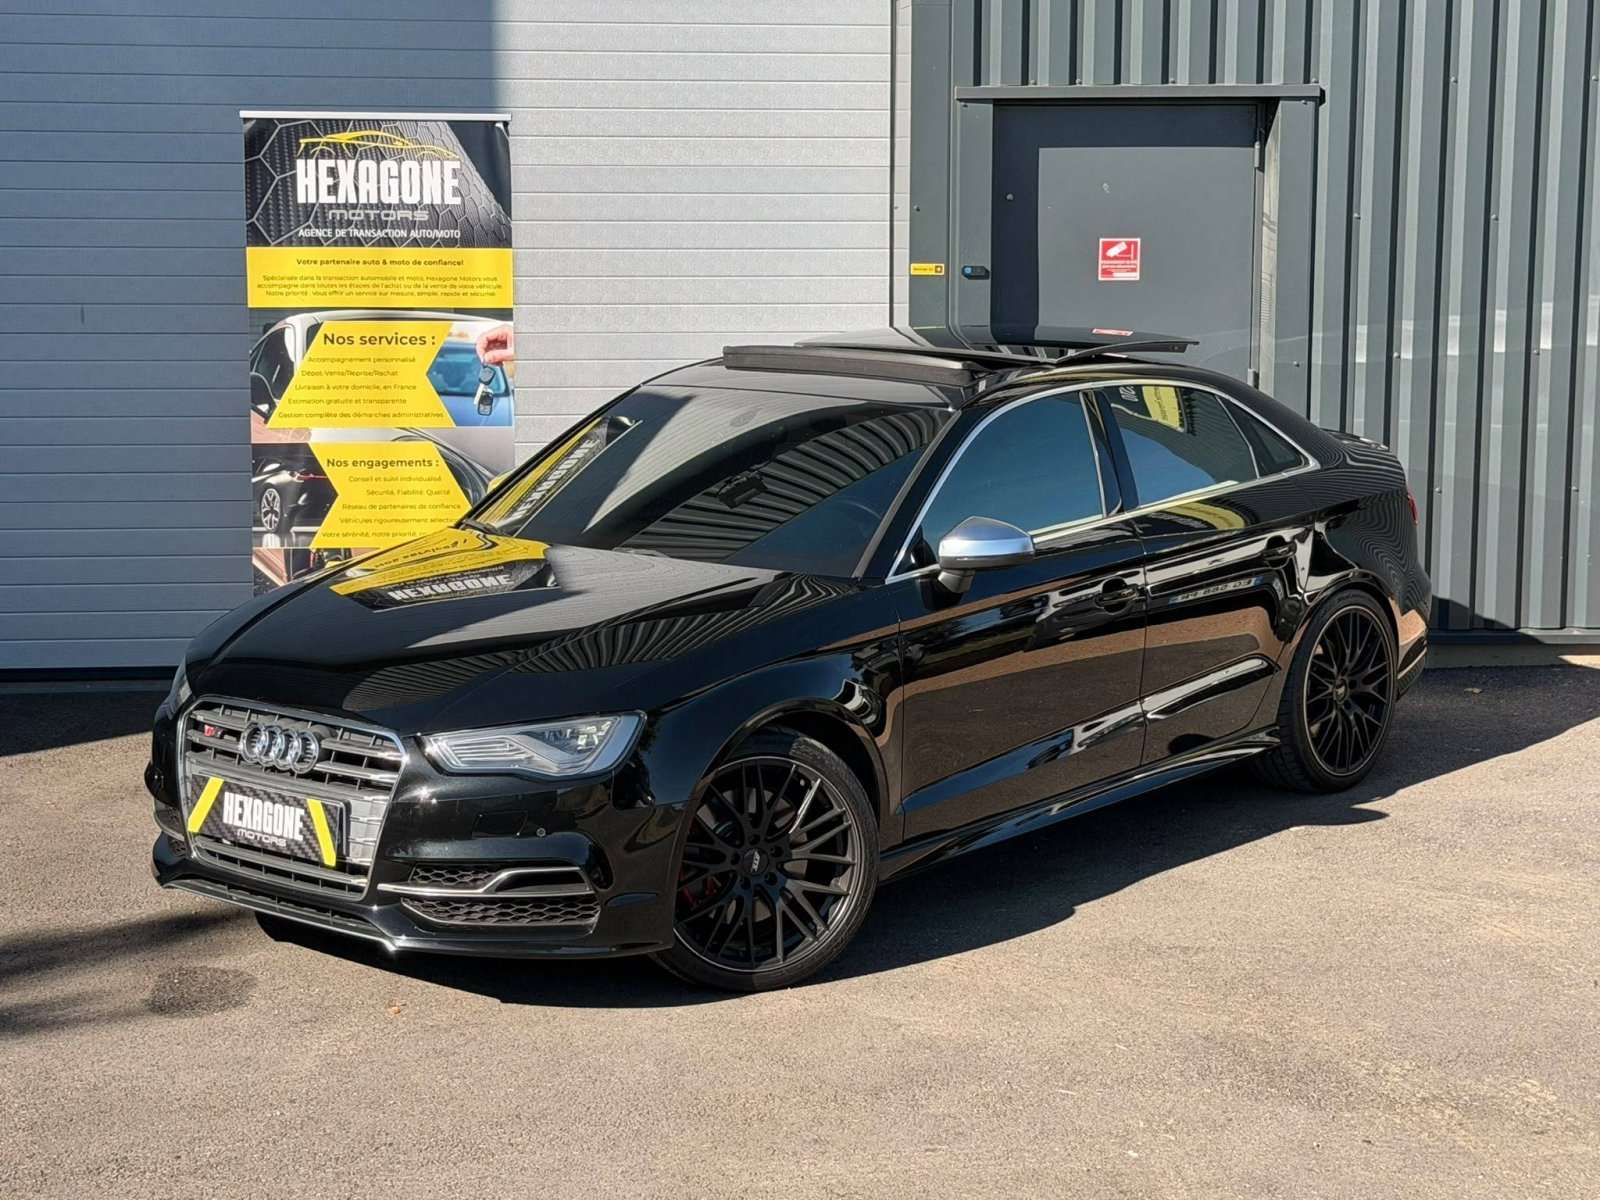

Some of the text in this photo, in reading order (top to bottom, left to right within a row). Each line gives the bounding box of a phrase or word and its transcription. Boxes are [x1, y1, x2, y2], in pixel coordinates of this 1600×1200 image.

[296, 158, 461, 205] HEXAGONE
[328, 209, 430, 221] MOTORS
[298, 228, 461, 239] AGENCE DE TRANSACTION AUTO/MOTO
[319, 258, 360, 266] partenaire
[323, 332, 436, 345] Nos services :
[373, 356, 416, 364] personnalisé
[325, 398, 353, 406] gratuite
[363, 398, 407, 406] transparente
[327, 458, 349, 467] Nos
[352, 458, 433, 469] engagements
[378, 503, 417, 511] partenaires
[374, 517, 429, 525] rigoureusement
[222, 790, 305, 842] HEXAGONE
[236, 828, 287, 848] MOTORS
